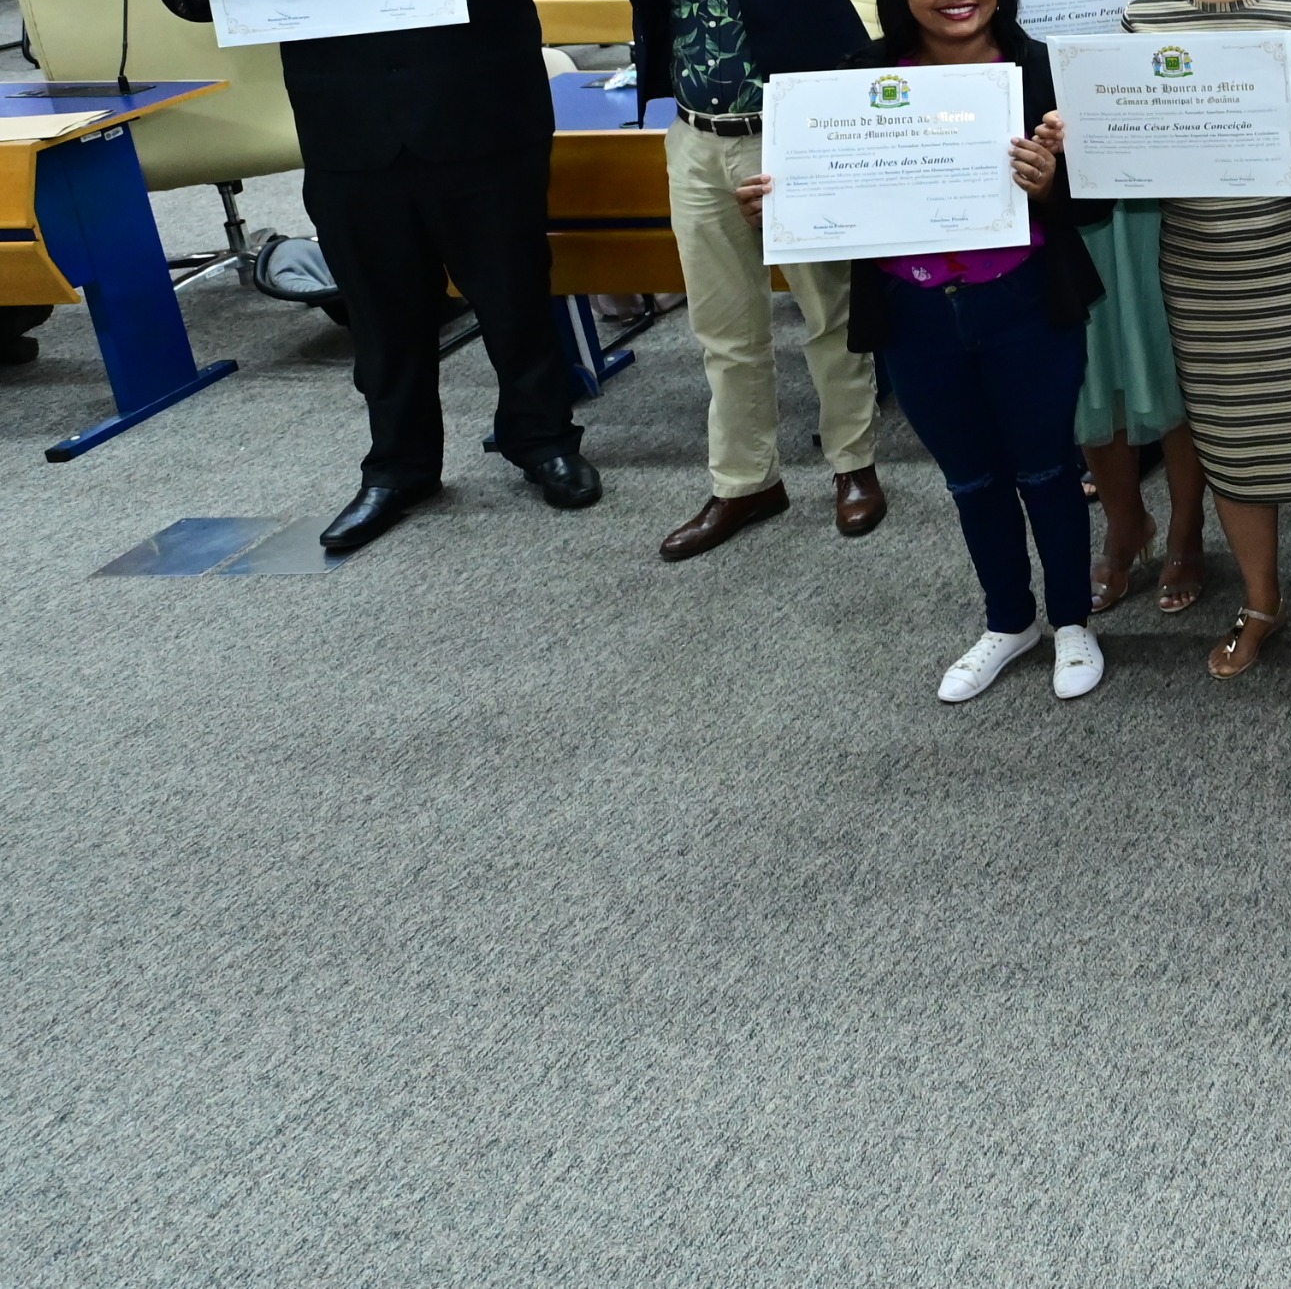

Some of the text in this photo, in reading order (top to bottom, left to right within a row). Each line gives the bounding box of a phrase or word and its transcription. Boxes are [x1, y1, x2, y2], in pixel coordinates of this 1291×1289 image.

[1055, 13, 1066, 21] de
[1068, 11, 1097, 20] Castro
[1100, 7, 1125, 16] Perdi
[1094, 81, 1255, 95] Diploma de Honra ao Mérito
[1115, 95, 1240, 106] Câmara Municipal de Goiânia
[808, 117, 856, 129] Diploma
[860, 116, 873, 127] de
[875, 114, 913, 126] Honra
[917, 115, 930, 124] ao
[1107, 121, 1252, 132] Idalina César Sousa Conceição
[826, 129, 920, 141] Câmara Municipal de
[828, 156, 955, 170] Marcela Alves dos Santos
